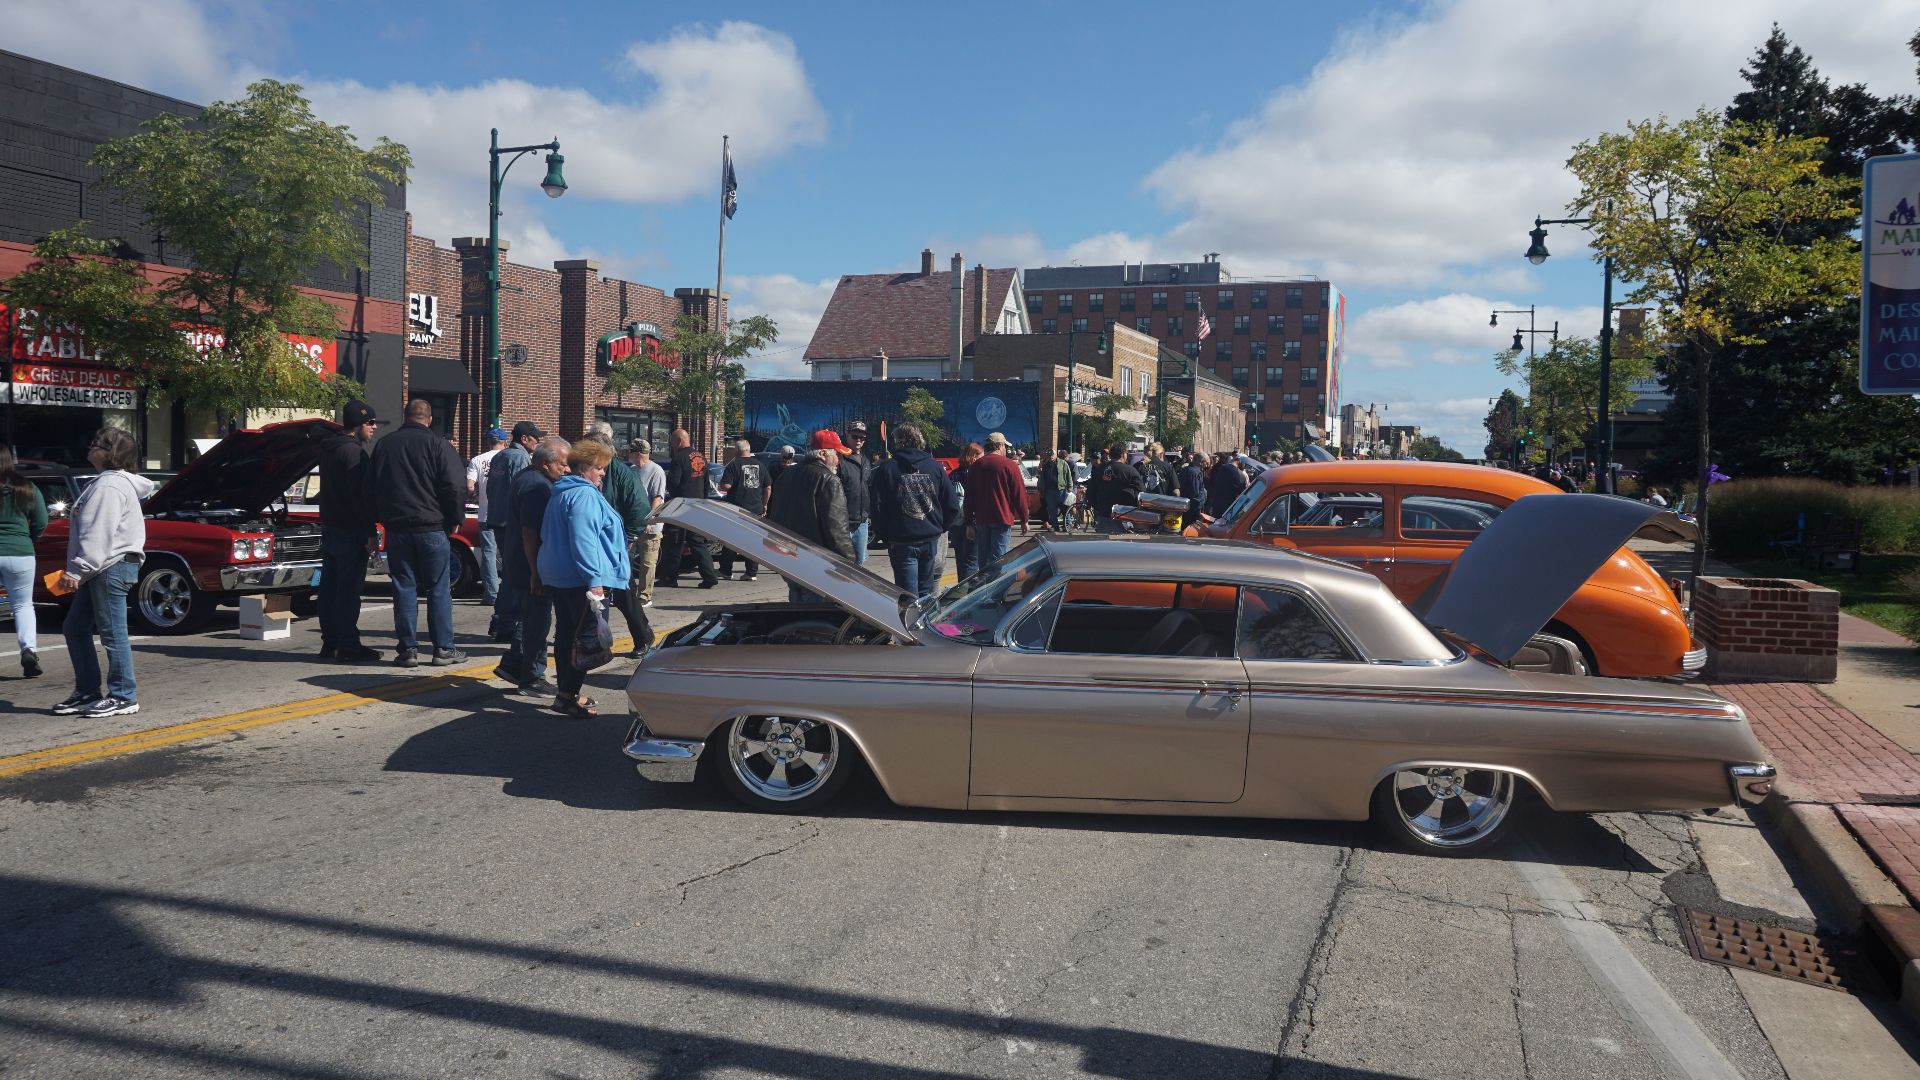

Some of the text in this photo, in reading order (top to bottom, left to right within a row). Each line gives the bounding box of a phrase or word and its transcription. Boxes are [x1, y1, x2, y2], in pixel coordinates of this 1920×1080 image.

[639, 323, 656, 333] PIZZA
[409, 333, 435, 344] PANY
[1883, 352, 1920, 371] CO
[30, 367, 121, 386] GREAT DEALS
[19, 386, 132, 405] WHOLESALE PRICES
